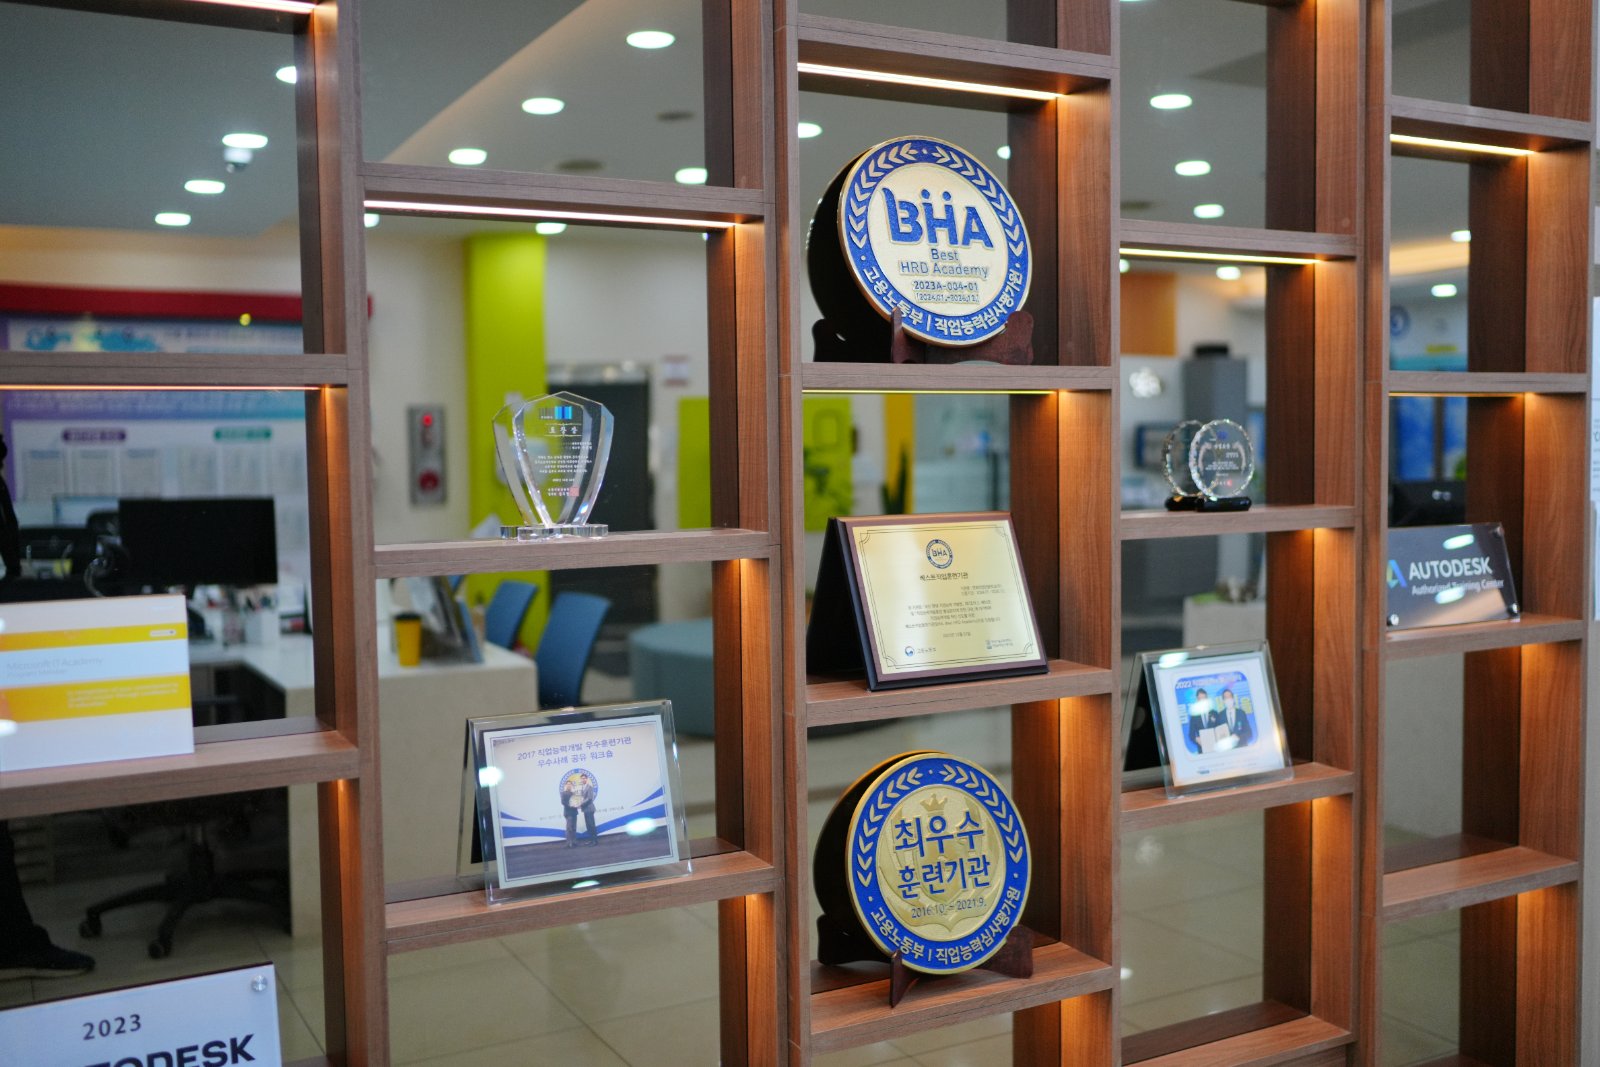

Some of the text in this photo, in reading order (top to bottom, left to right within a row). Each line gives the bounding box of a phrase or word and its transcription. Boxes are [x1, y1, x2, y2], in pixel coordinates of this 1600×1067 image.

[881, 187, 994, 249] BHA
[930, 248, 959, 261] Best
[900, 261, 988, 279] HRD Academy
[913, 280, 978, 291] 2023A-004-01
[863, 265, 1024, 336] 고용노동부 직업능력심사평가원
[931, 547, 948, 557] BHA
[1409, 557, 1492, 580] AUTODESK
[517, 736, 632, 761] 2017 직업능력개발 우수훈련기관
[537, 758, 569, 768] 우수사례
[571, 753, 587, 763] 공유
[895, 811, 984, 857] 최우수
[898, 855, 990, 899] 훈련기관
[870, 885, 1022, 965] 고용노동부 직업능력심사평가원
[82, 1013, 143, 1041] 2023
